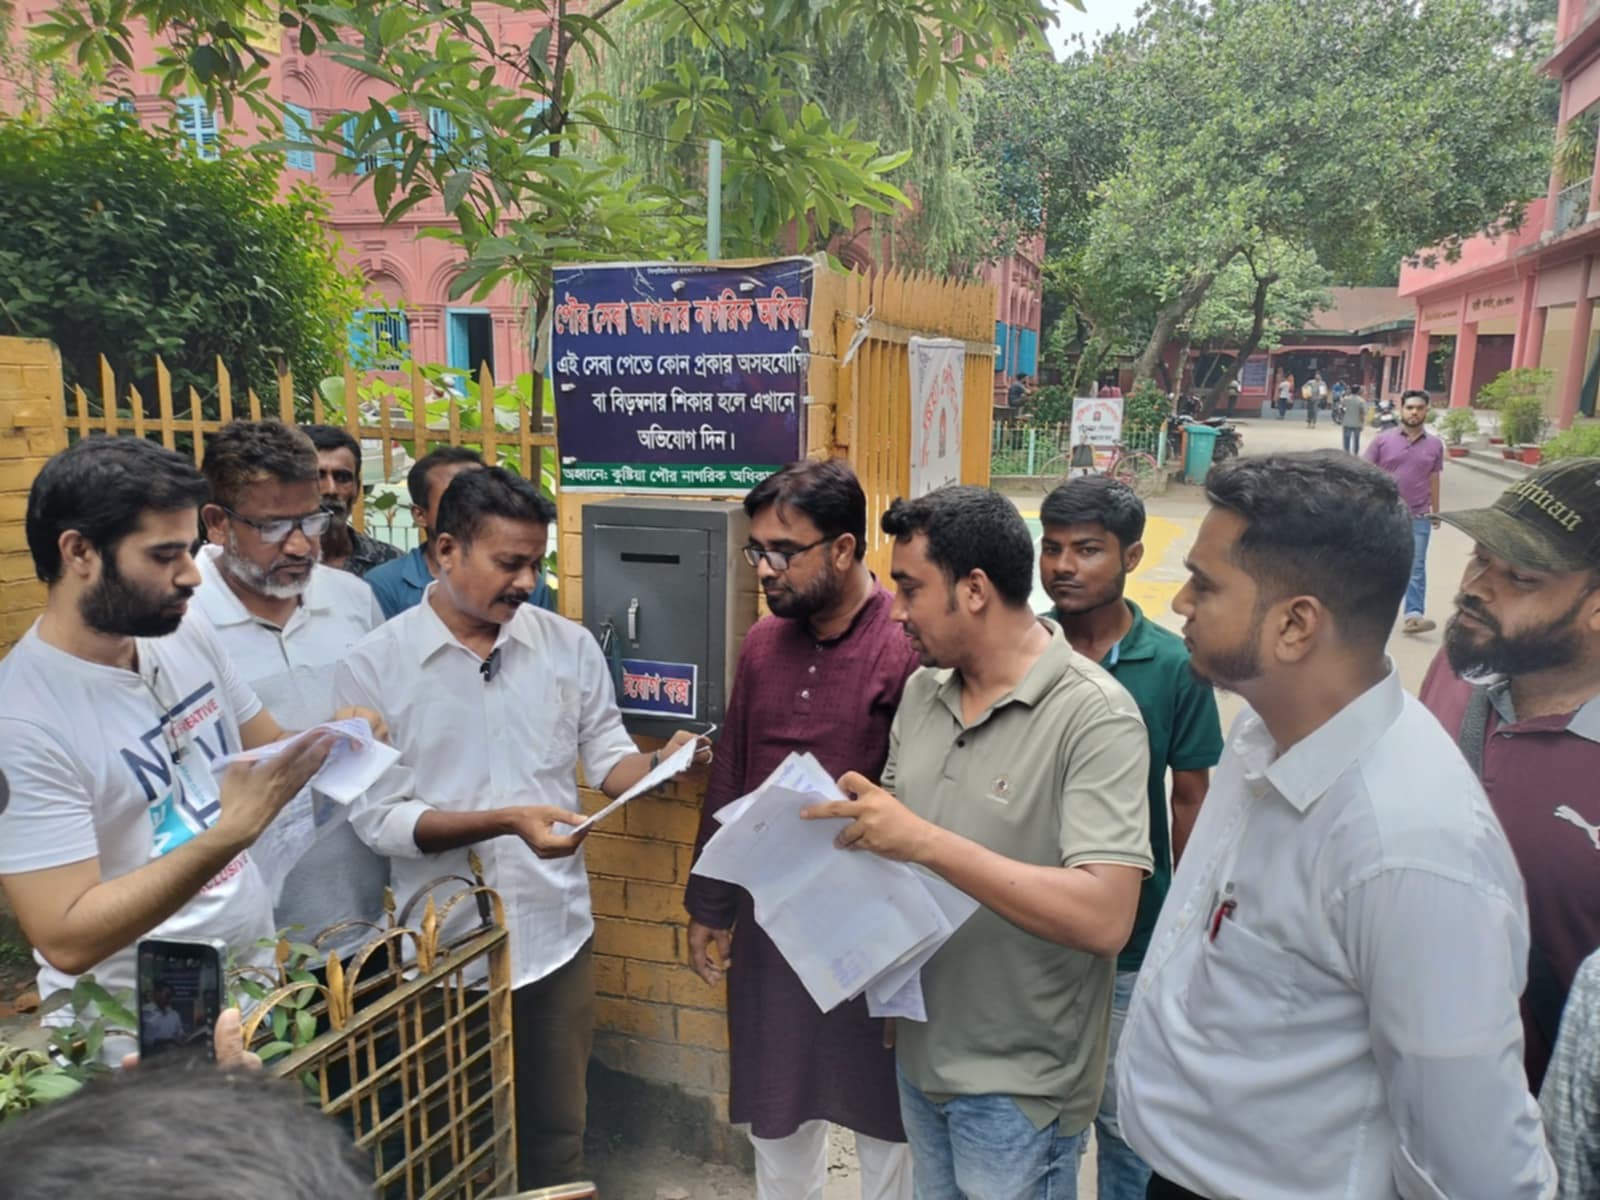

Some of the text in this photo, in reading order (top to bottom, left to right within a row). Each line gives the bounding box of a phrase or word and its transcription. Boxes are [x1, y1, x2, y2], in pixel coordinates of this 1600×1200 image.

[555, 291, 591, 335] পৌর
[592, 298, 628, 336] সেবা
[629, 297, 690, 335] আপনার
[692, 287, 754, 334] নাগরিক
[557, 349, 579, 376] এই
[583, 354, 613, 375] সেবা
[617, 353, 654, 375] পেতে
[657, 353, 690, 375] কোন
[694, 352, 734, 378] প্রকার
[592, 386, 796, 416] বা বিড়ম্বনার শিকার হলে এখানে
[636, 423, 697, 450] অভিযোগ
[699, 423, 727, 450] দিন
[649, 466, 678, 482] পৌর
[681, 466, 727, 483] নাগরিক
[729, 466, 775, 483] অধিকা
[170, 697, 219, 738] CREATIVE
